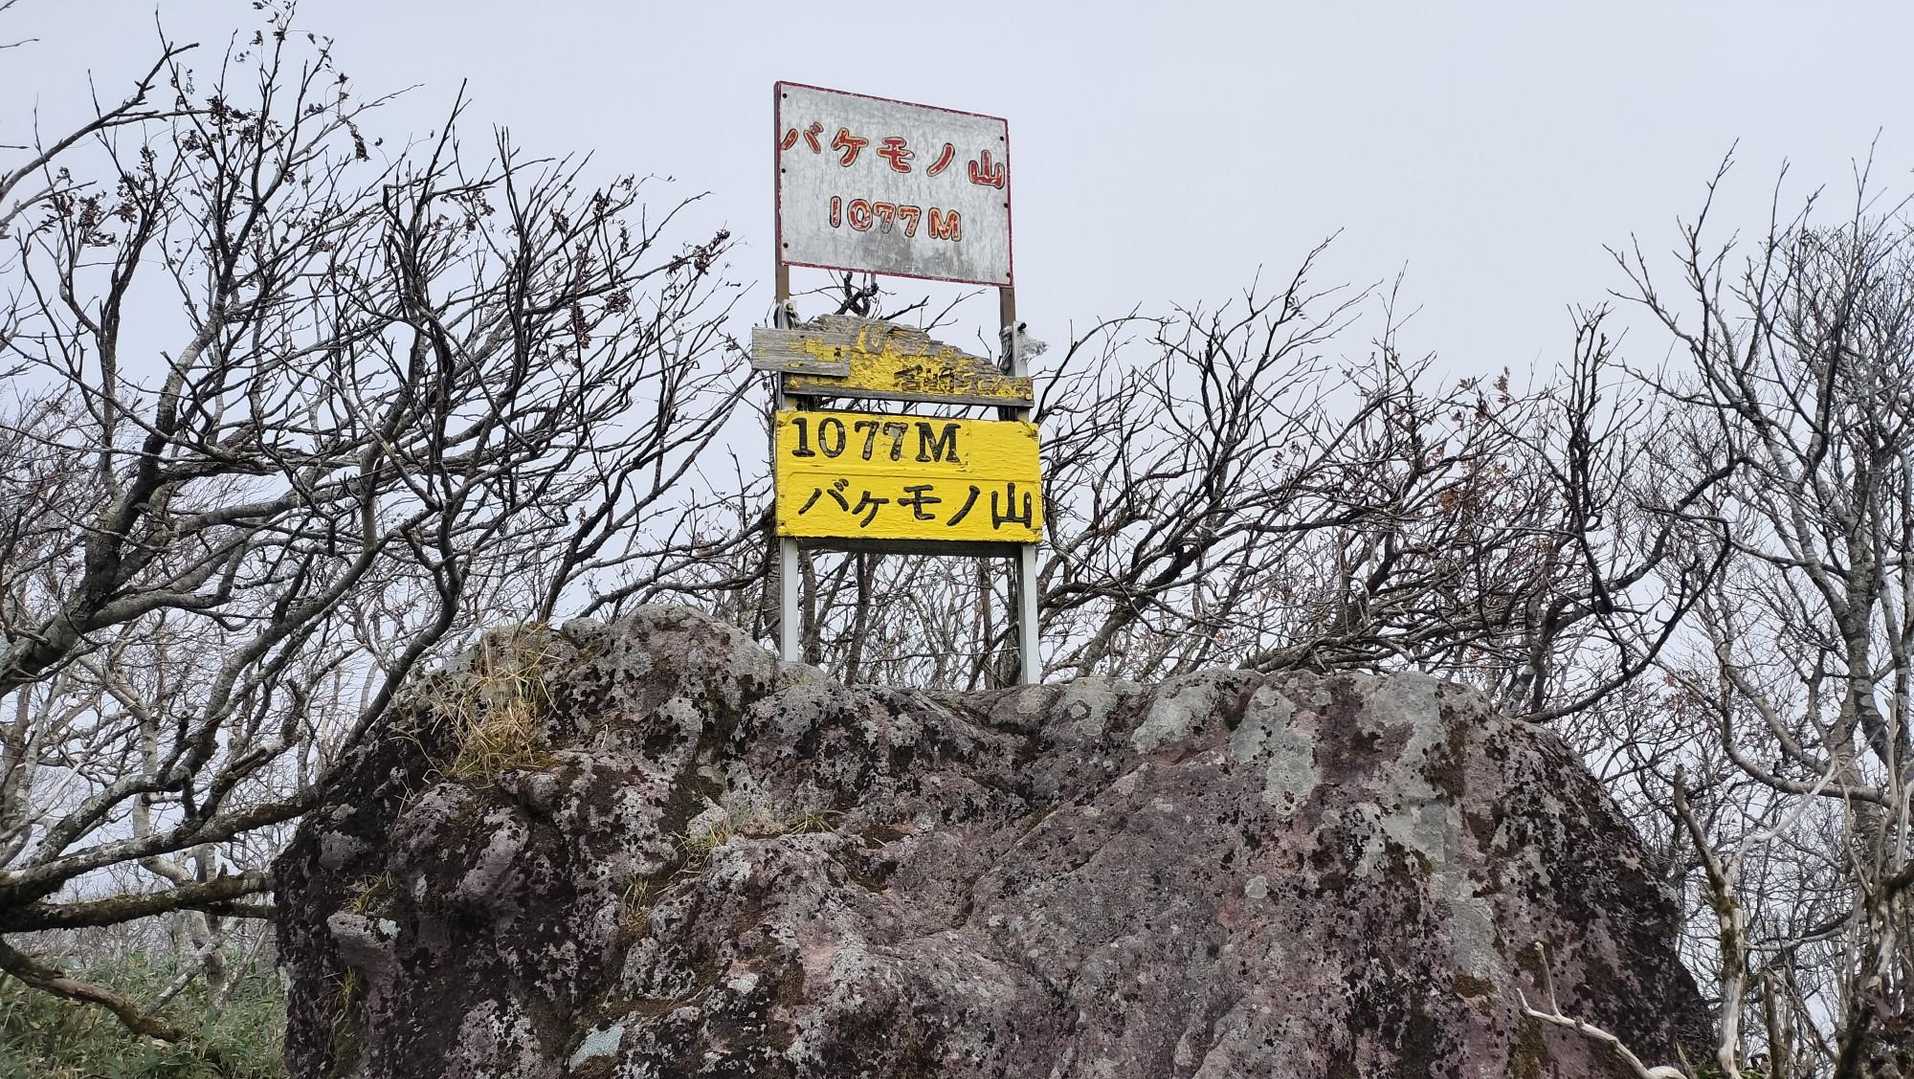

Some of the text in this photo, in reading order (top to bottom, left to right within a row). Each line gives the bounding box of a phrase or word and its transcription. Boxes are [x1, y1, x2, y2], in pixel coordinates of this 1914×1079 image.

[781, 120, 1005, 190] バケモノ山
[829, 195, 962, 242] 1077M
[791, 417, 962, 463] 1077M
[798, 478, 1032, 530] バケモノ山
